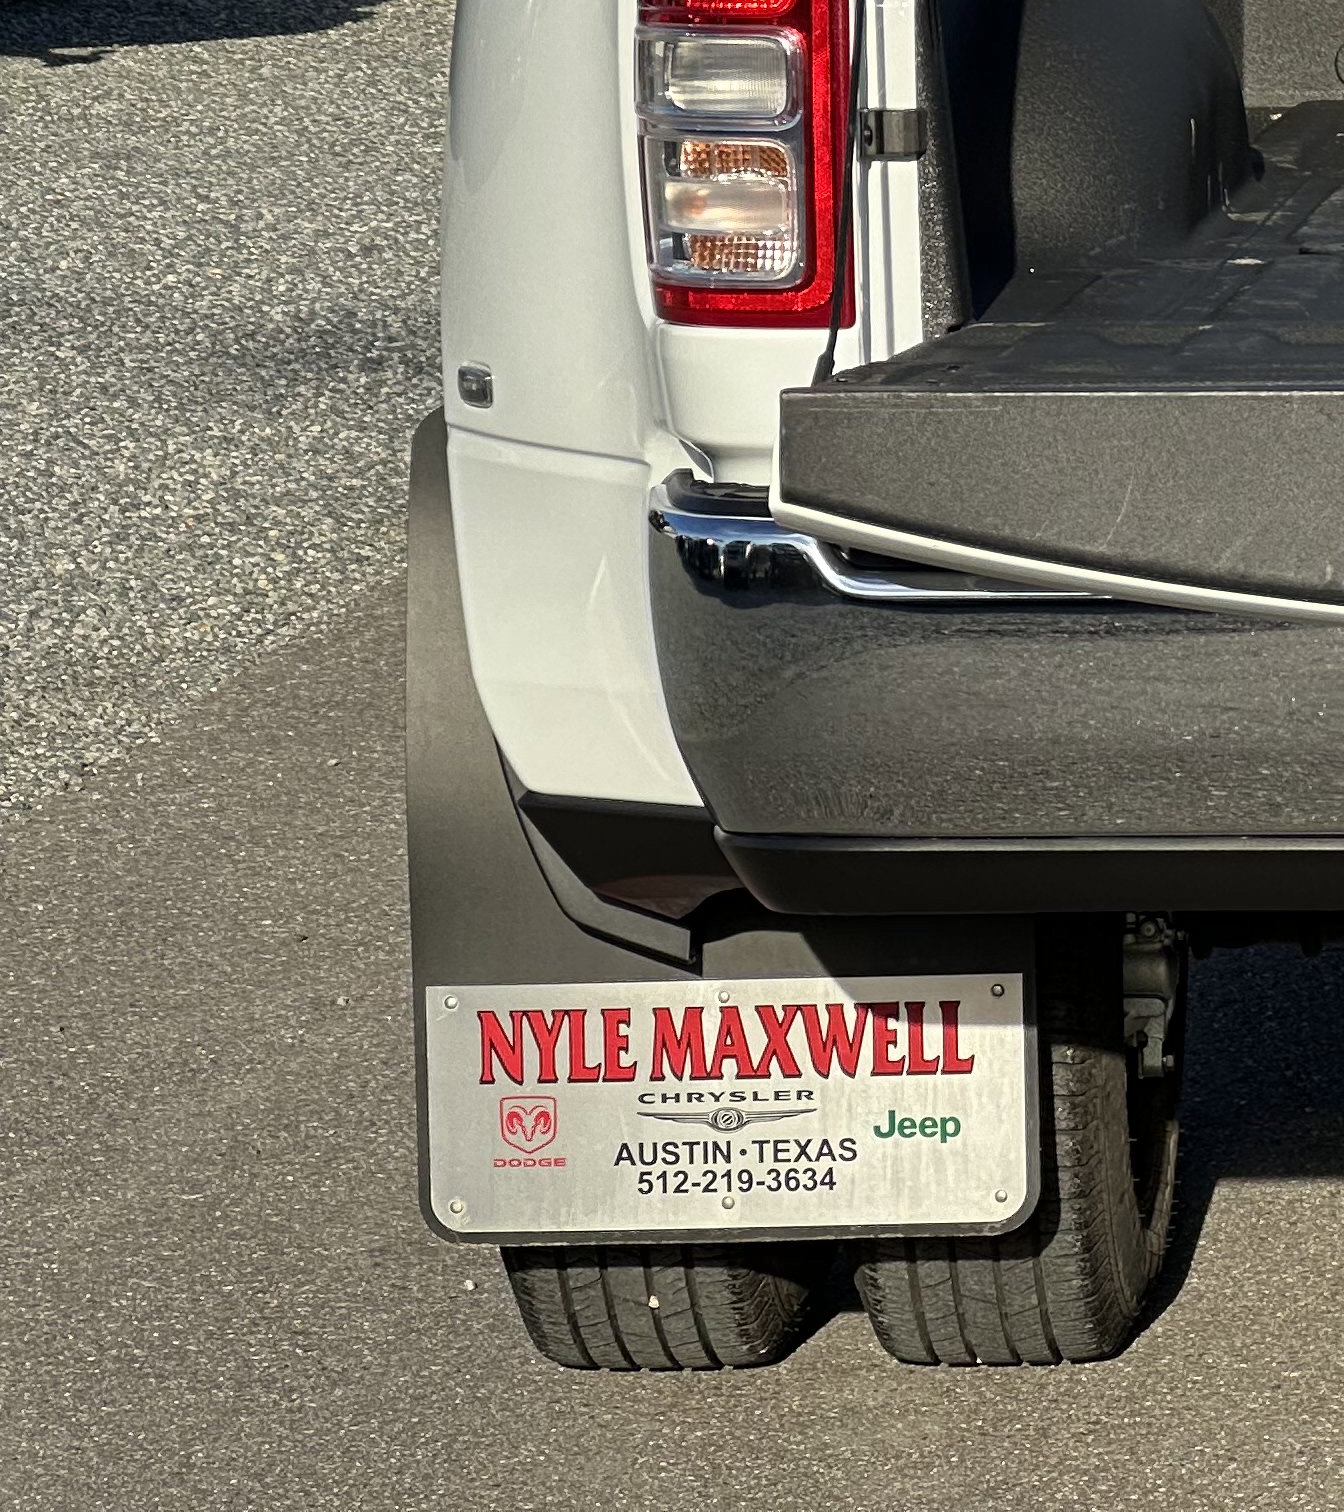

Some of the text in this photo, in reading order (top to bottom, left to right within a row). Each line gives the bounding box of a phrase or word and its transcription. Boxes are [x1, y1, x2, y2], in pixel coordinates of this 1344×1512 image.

[477, 1000, 975, 1085] NYLE MAXWELL
[637, 1089, 815, 1104] CHRYSLER
[873, 1110, 962, 1143] Jeep
[493, 1157, 567, 1168] DODGE
[613, 1139, 858, 1167] AUSTIN TEXAS
[636, 1169, 837, 1195] 512-219-3634
